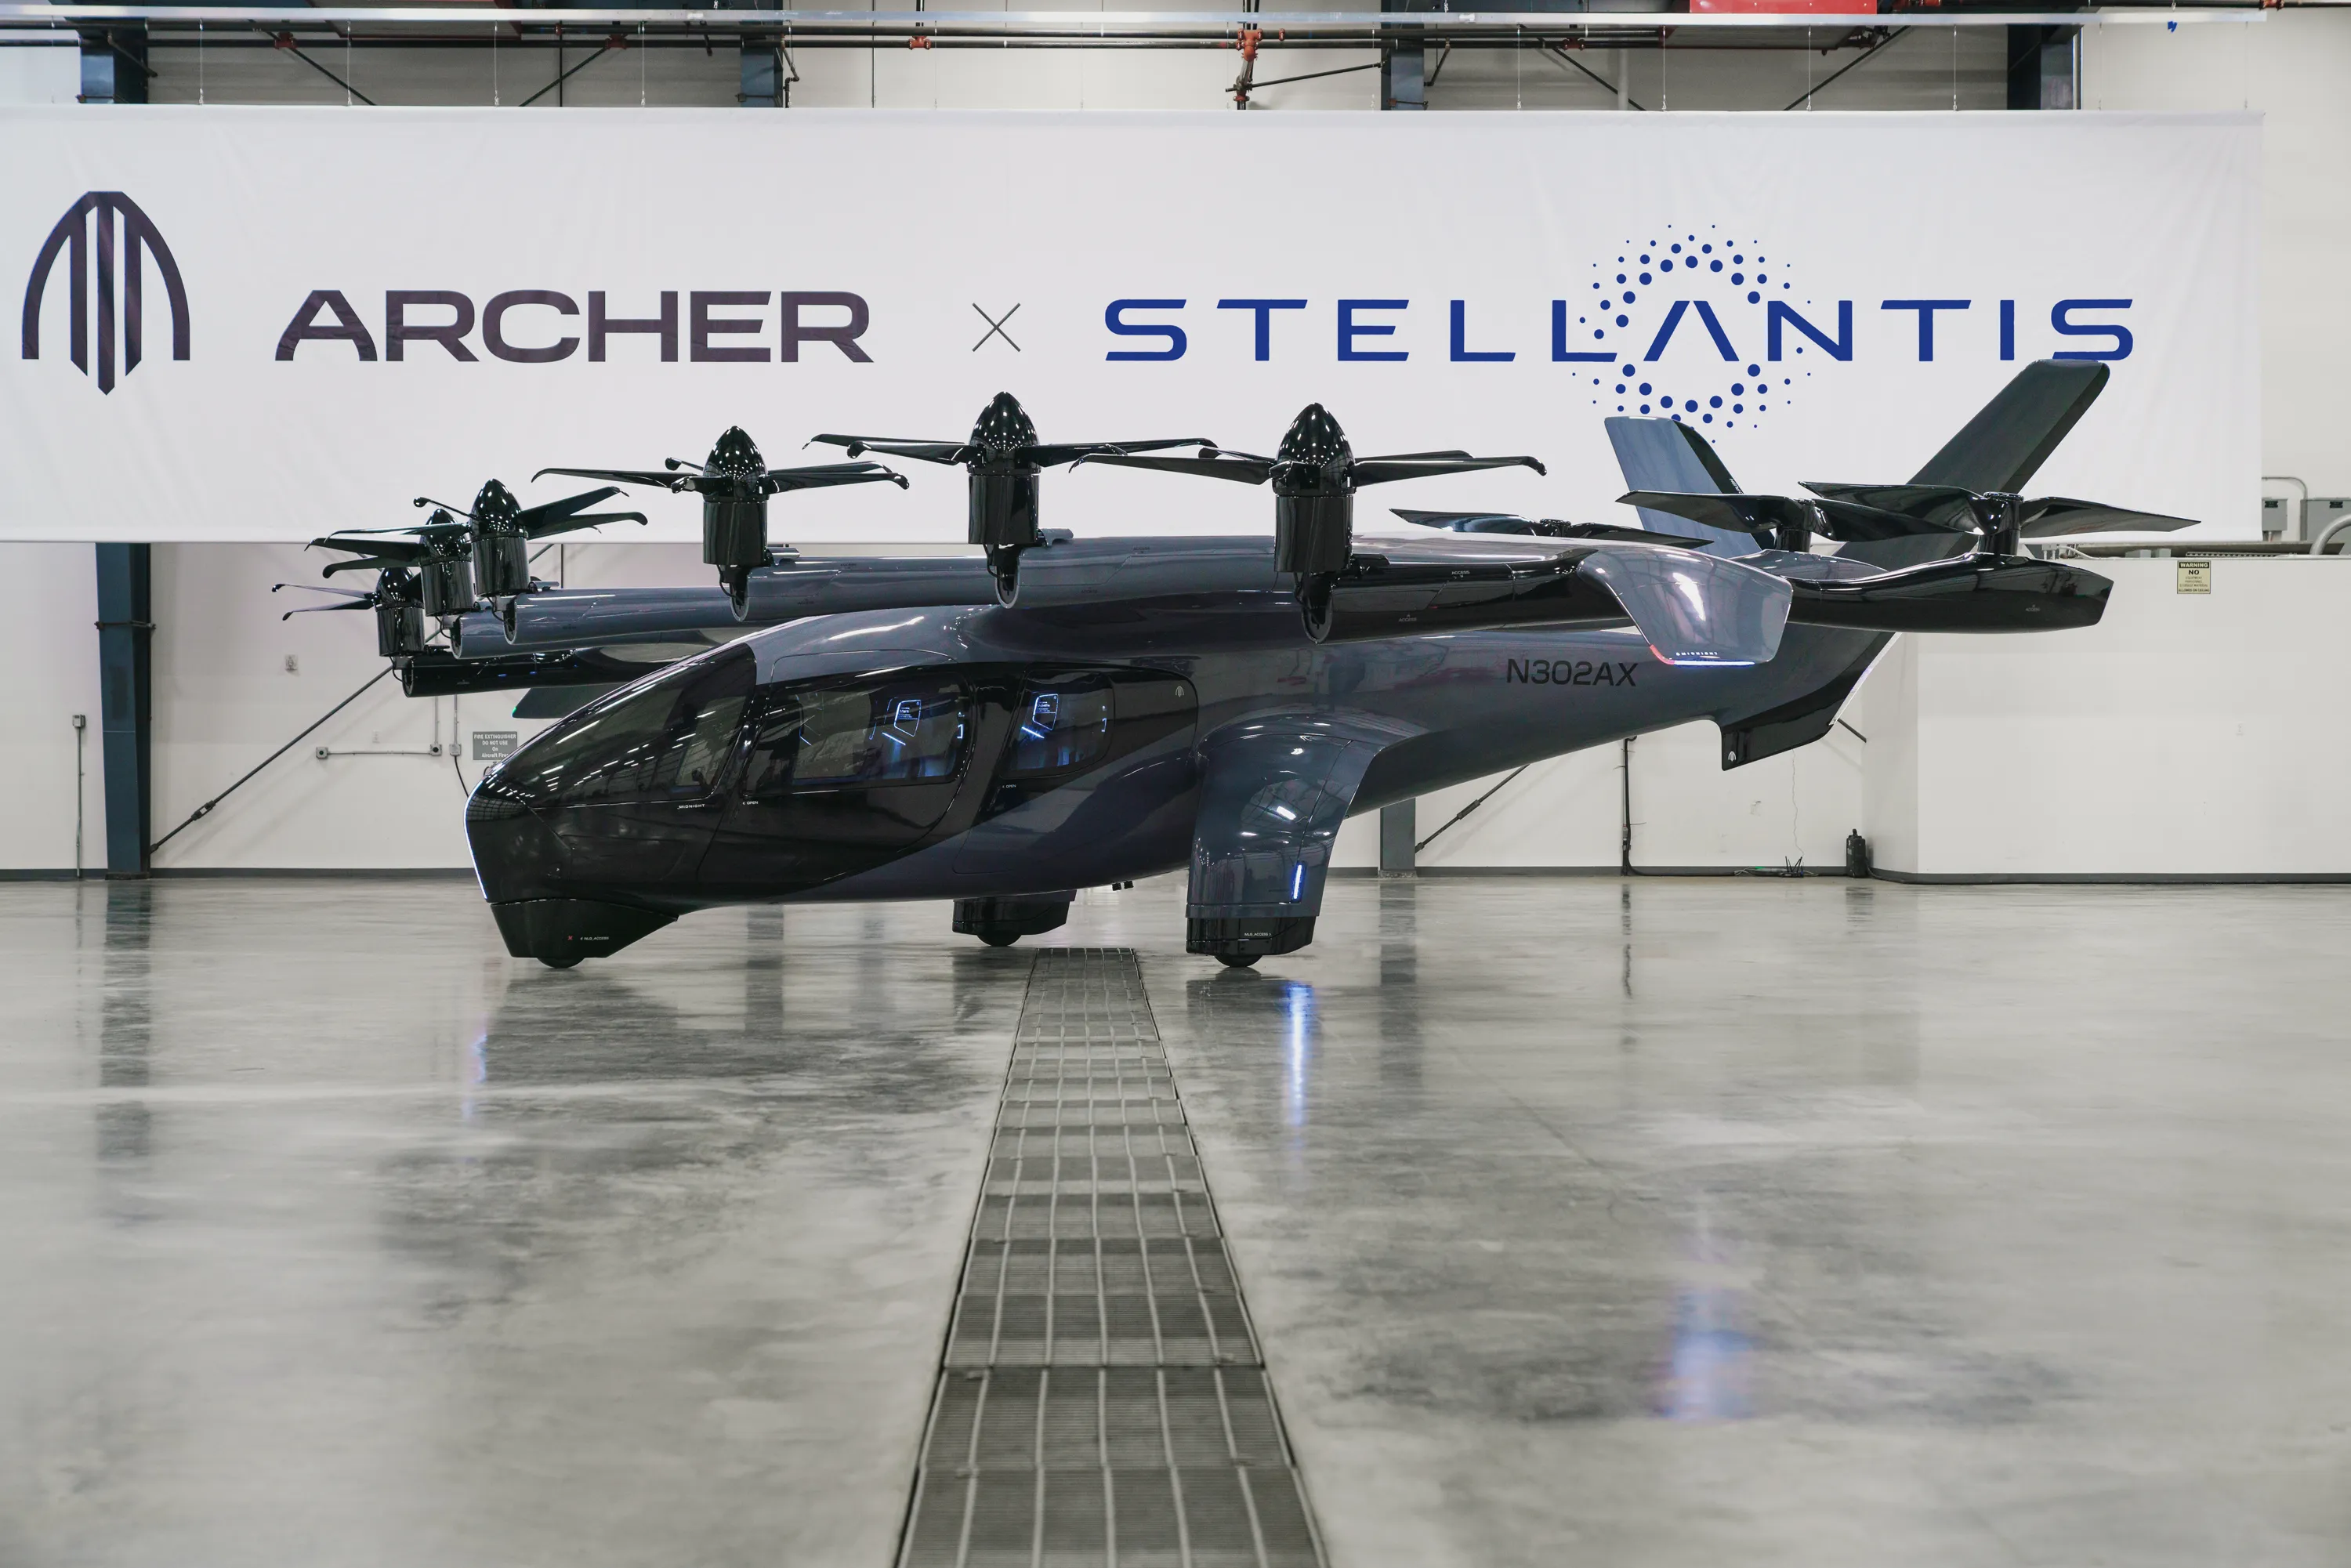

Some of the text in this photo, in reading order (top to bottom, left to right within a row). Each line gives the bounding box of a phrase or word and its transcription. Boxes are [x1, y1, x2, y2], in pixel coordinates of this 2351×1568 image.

[275, 290, 874, 363] ARCHER
[1105, 299, 2133, 361] STELLANTIS
[1506, 658, 1639, 687] N302AX
